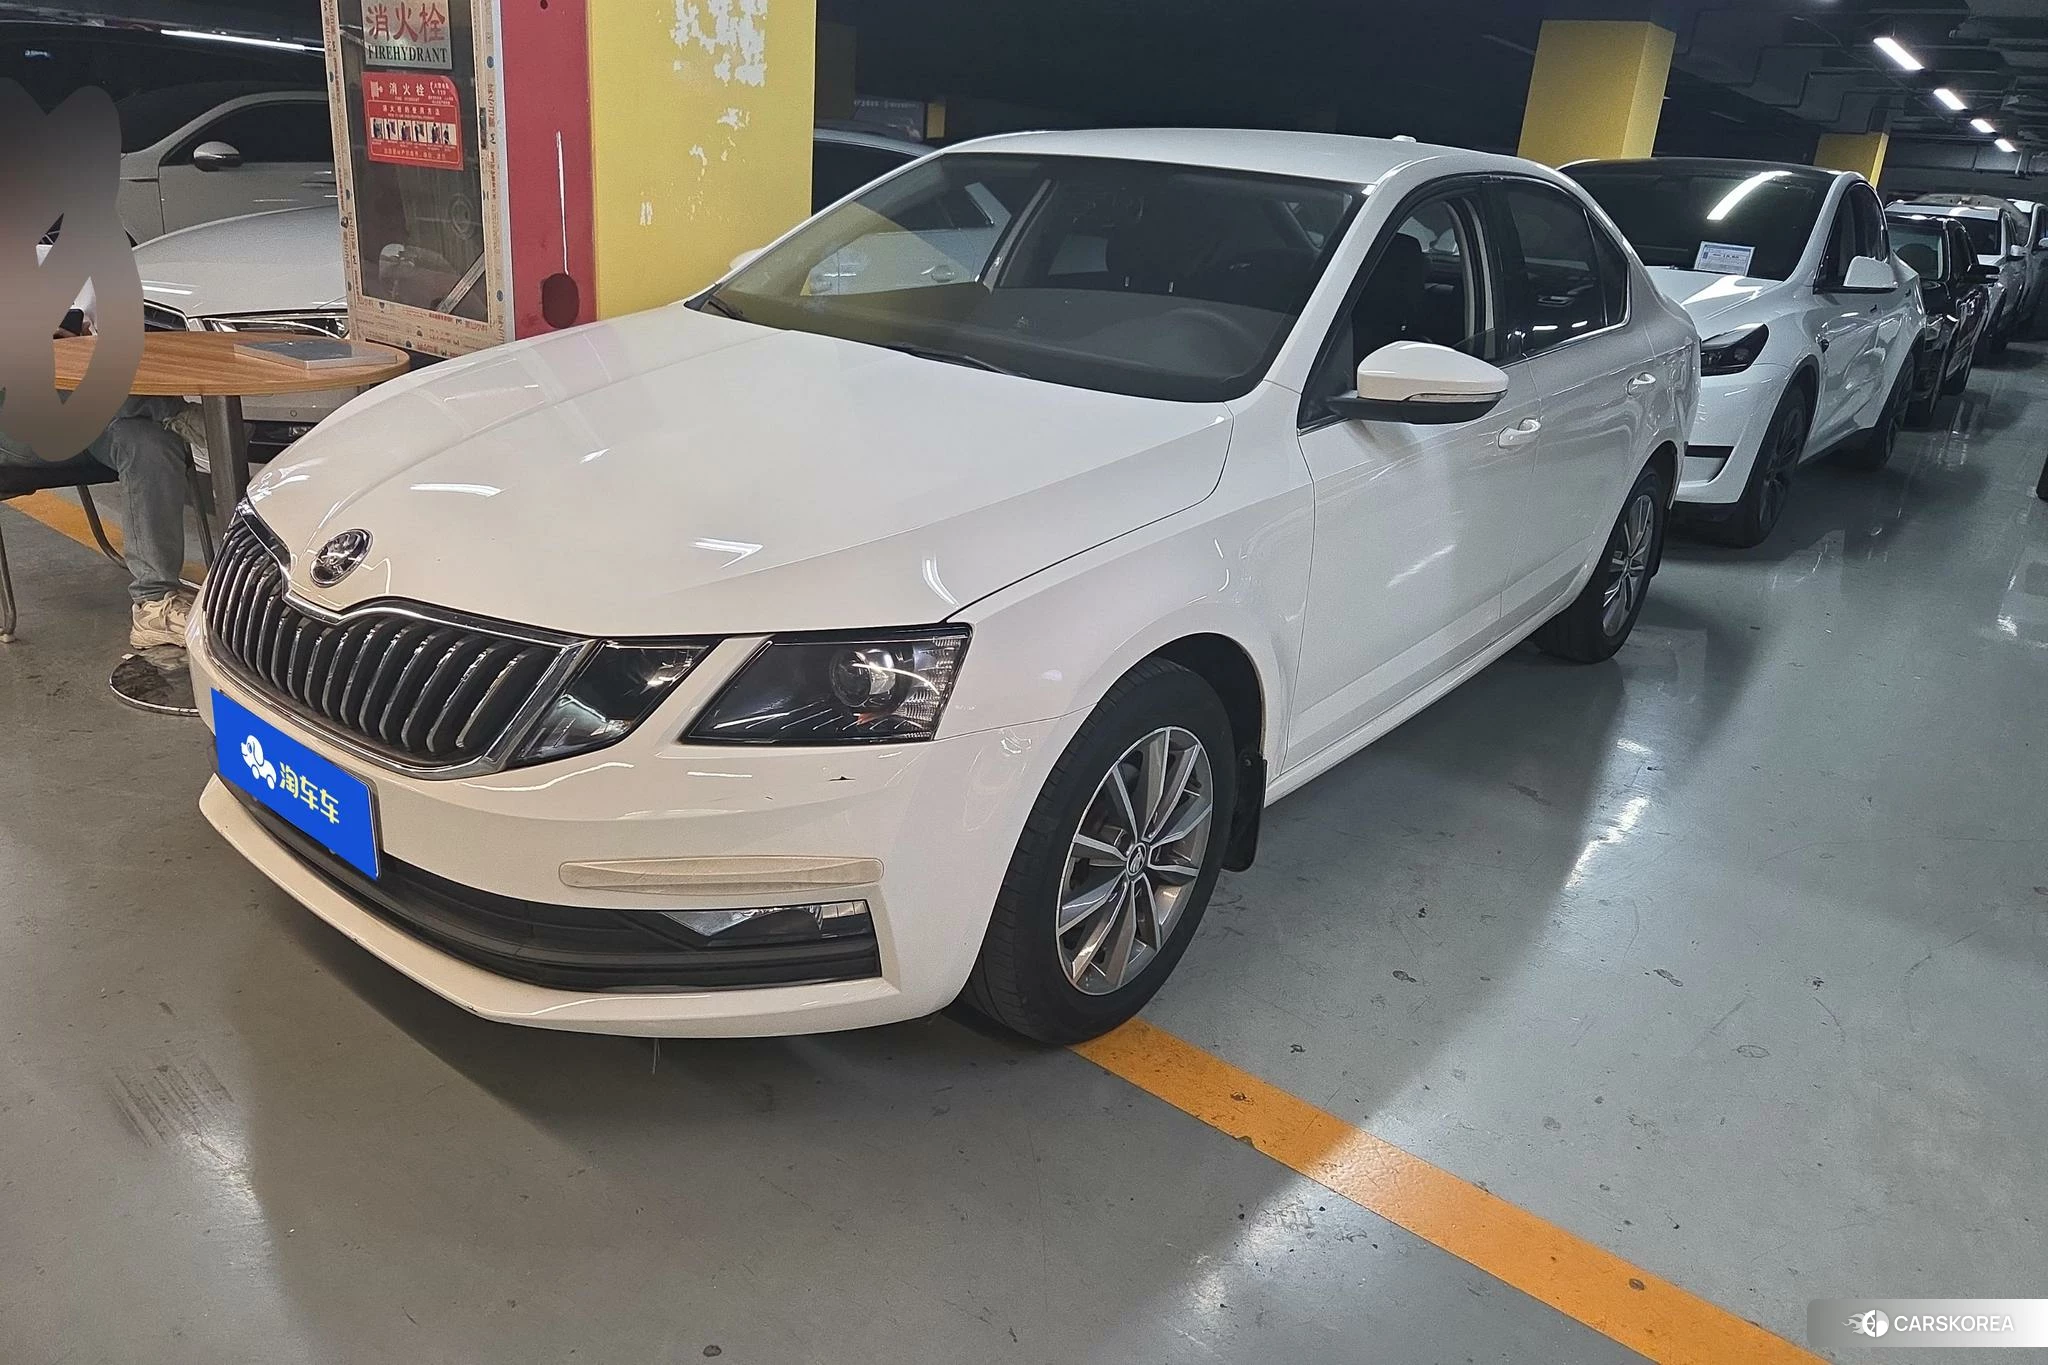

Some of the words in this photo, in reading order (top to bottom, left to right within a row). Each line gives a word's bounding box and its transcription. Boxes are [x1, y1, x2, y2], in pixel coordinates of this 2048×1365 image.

[366, 1, 446, 42] 消火栓
[368, 44, 447, 63] FIREHYDRANT
[389, 82, 424, 96] 消火栓
[279, 761, 340, 824] 淘车车
